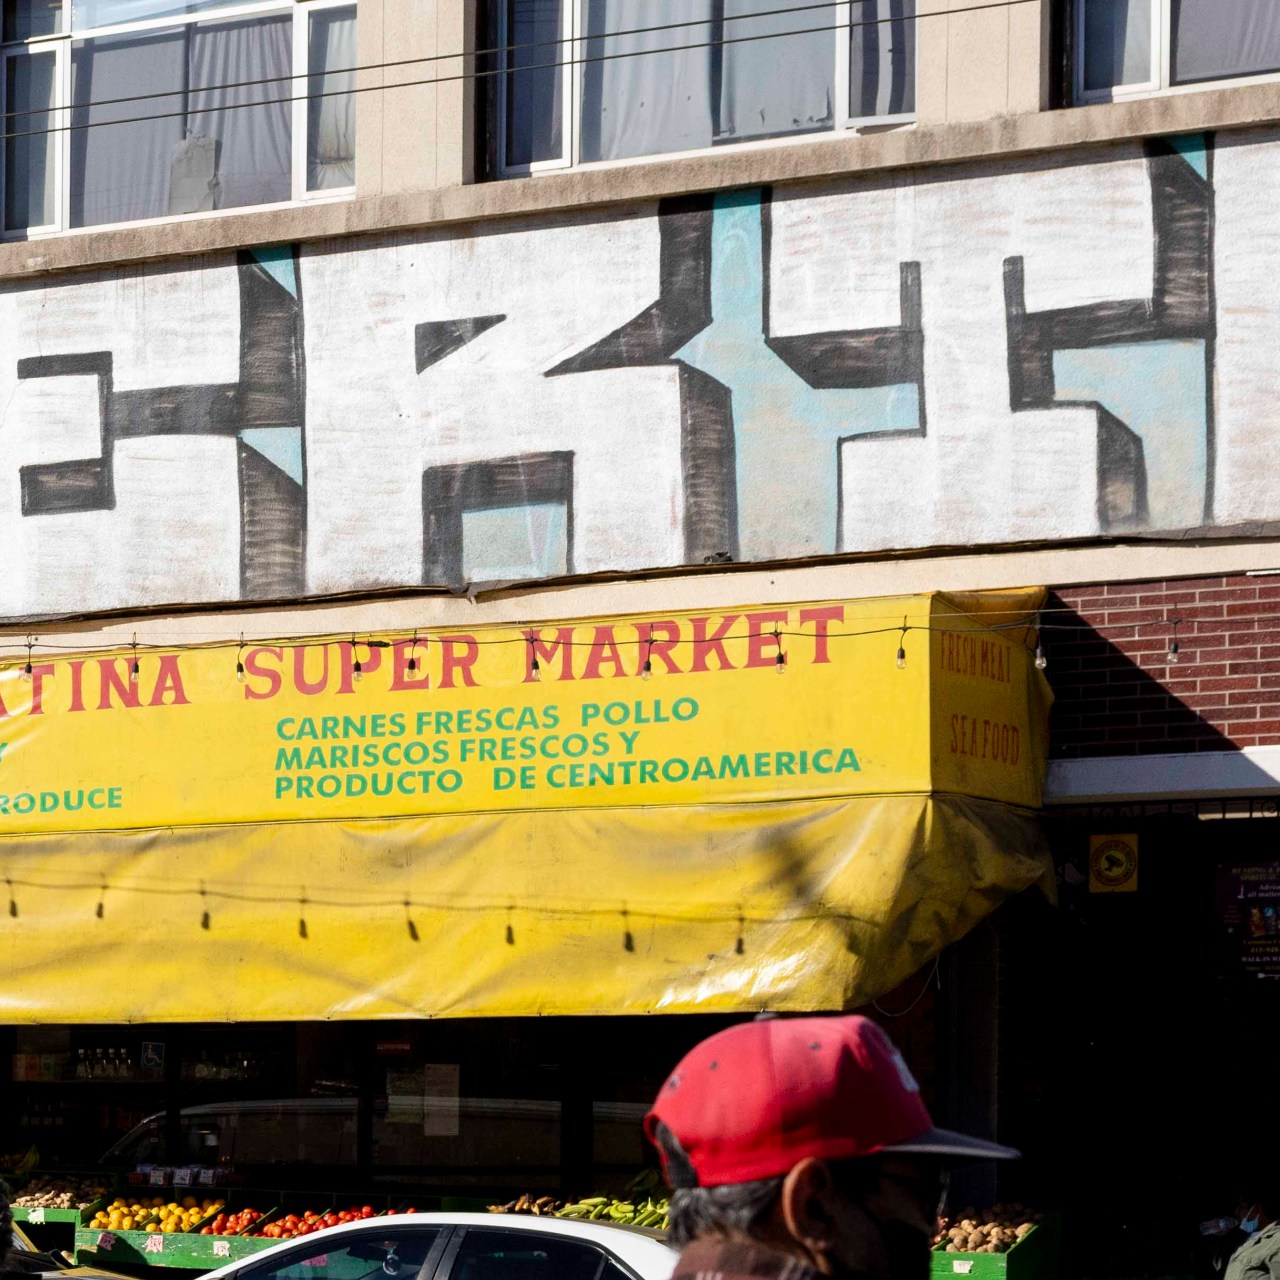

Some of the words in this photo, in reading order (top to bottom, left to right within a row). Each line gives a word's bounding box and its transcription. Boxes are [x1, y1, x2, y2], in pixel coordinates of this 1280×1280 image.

[244, 634, 483, 700] SUPER
[520, 605, 845, 684] MARKET
[941, 630, 976, 676] FRESH
[981, 640, 1010, 683] MEAT
[276, 712, 406, 741] CARNES
[416, 705, 560, 735] FRESCAS
[581, 697, 700, 727] POLLO
[950, 714, 977, 757] SEA
[982, 719, 1020, 766] FOOD
[275, 739, 449, 771] MARISCOS
[459, 731, 610, 762] FRESCOS
[619, 730, 640, 755] Y
[275, 768, 463, 799] PRODUCTO
[493, 766, 536, 791] DE
[546, 747, 862, 789] CENTROAMERICA
